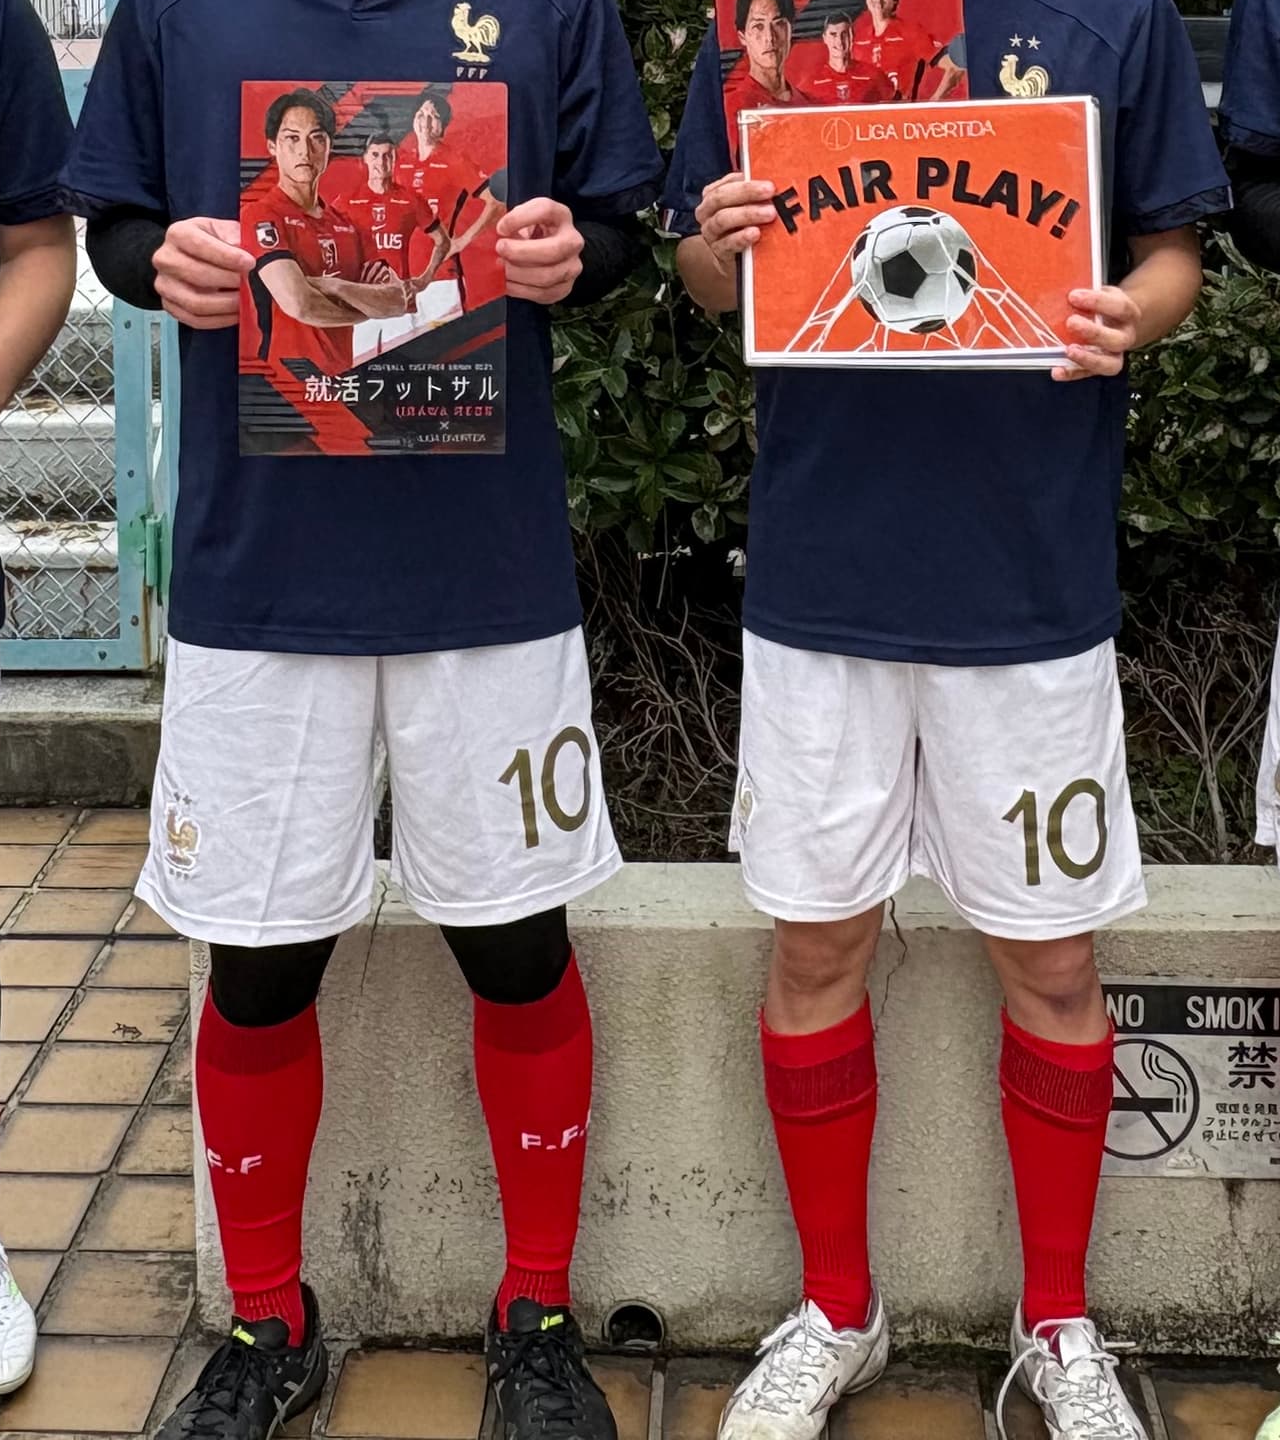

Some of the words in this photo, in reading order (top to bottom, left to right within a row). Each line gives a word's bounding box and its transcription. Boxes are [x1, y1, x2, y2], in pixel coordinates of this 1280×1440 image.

[856, 123, 898, 141] LIGA
[903, 120, 996, 140] DIVERTIDA
[773, 159, 897, 235] FAIR
[917, 156, 1080, 239] PLAY!
[304, 374, 500, 403] 就活フットサル
[497, 725, 592, 850] 10
[1001, 778, 1109, 887] 10
[1106, 992, 1145, 1028] NO
